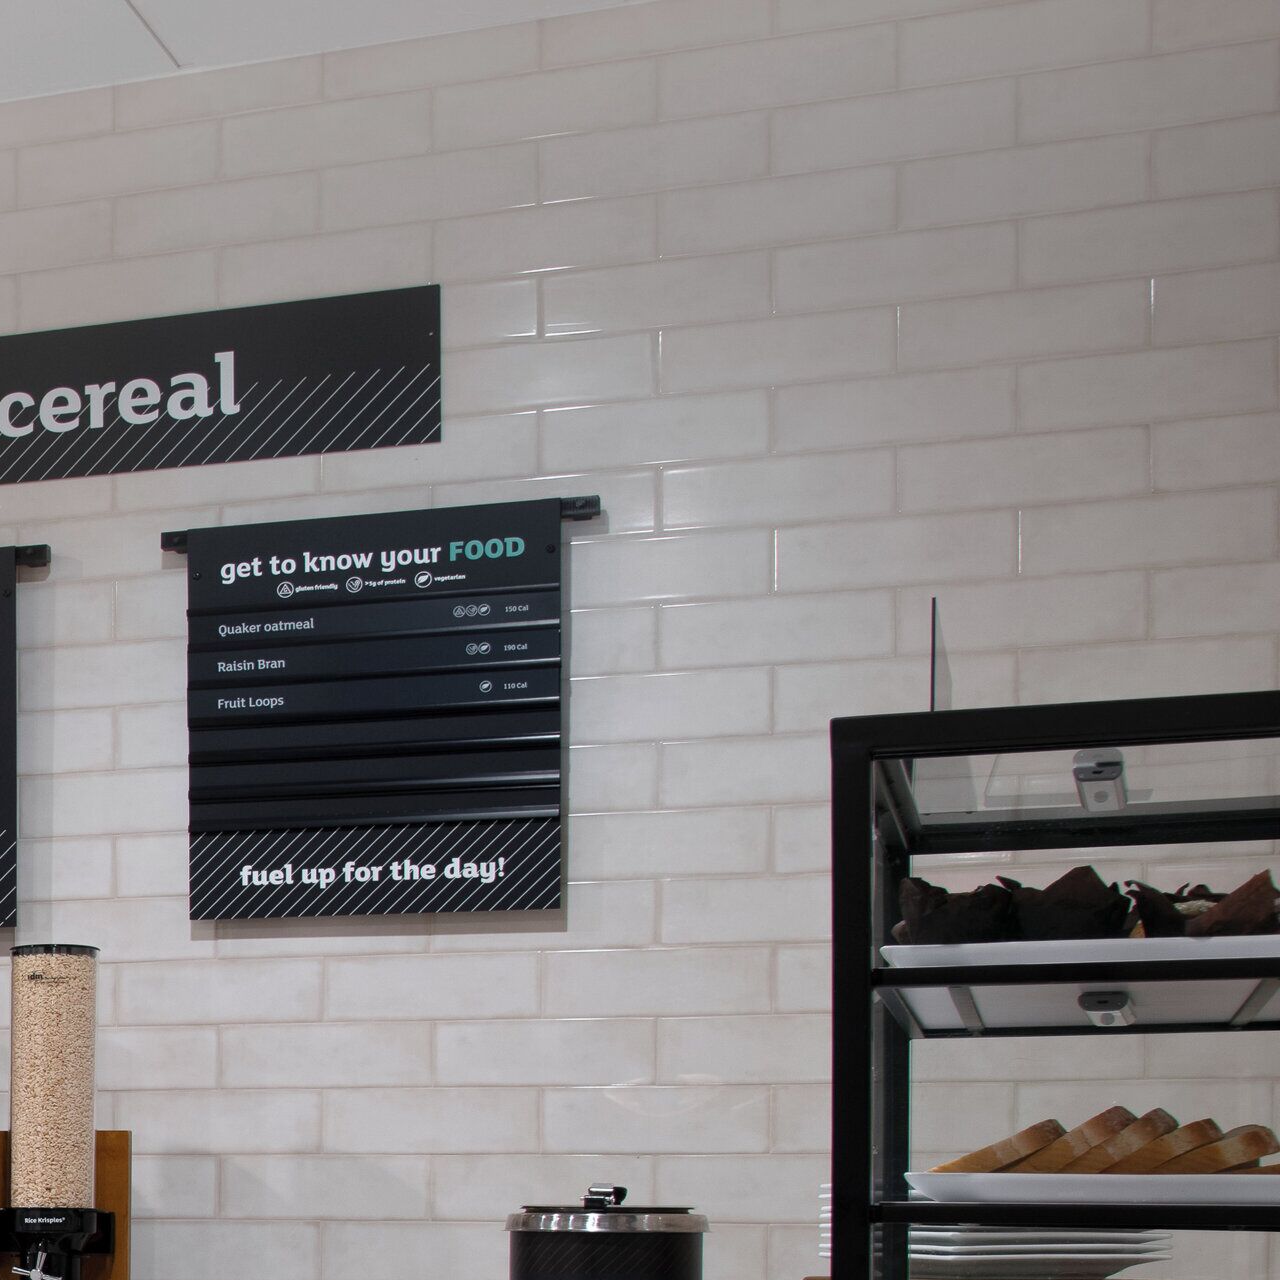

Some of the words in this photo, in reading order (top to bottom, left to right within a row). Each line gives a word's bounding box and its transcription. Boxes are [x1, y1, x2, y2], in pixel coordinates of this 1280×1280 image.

[221, 558, 262, 584] get
[269, 556, 296, 575] to
[303, 552, 373, 572] know
[381, 547, 441, 573] your
[450, 537, 525, 561] FOOD
[506, 605, 516, 613] 150
[518, 604, 528, 612] Cal
[219, 623, 261, 637] Quaker
[264, 618, 314, 631] oatmeal
[504, 643, 516, 652] 190
[517, 643, 527, 651] Cal
[218, 660, 254, 672] Raisin
[258, 659, 285, 670] Bran
[504, 682, 515, 690] 110
[517, 681, 527, 689] Cal
[218, 697, 245, 710] Fruit
[249, 696, 284, 709] Loops
[240, 863, 294, 886] fuel
[301, 867, 336, 889] up
[343, 861, 382, 882] for
[389, 859, 436, 881] the
[443, 857, 506, 884] day!
